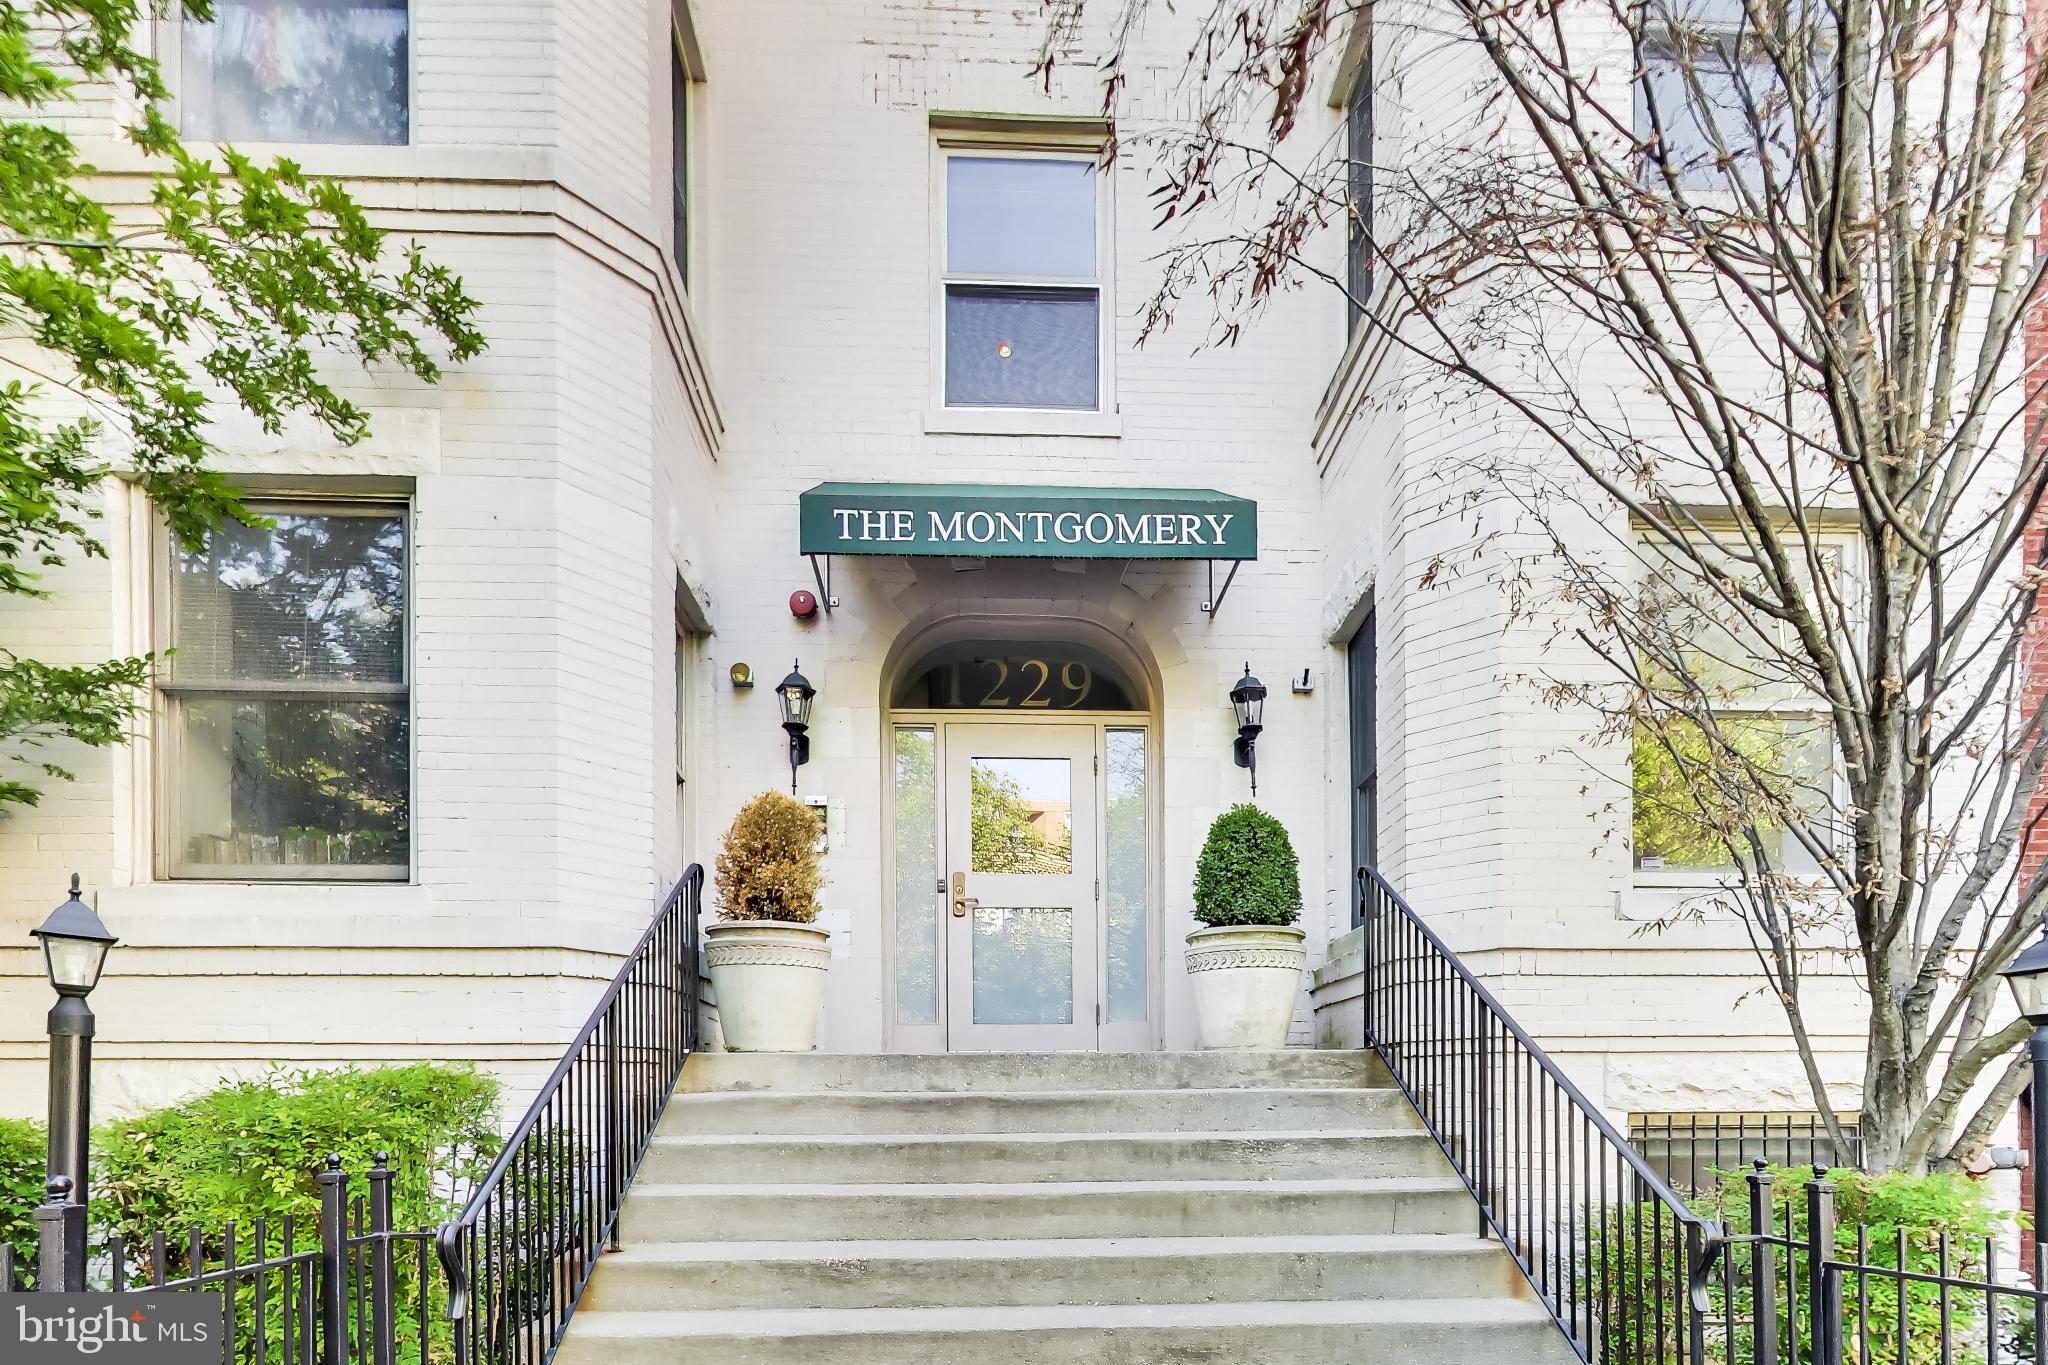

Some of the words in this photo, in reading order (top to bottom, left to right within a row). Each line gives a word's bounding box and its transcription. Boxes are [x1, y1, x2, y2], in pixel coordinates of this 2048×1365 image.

[833, 508, 916, 541] THE
[927, 511, 1234, 545] MONTGOMERY
[945, 659, 1092, 708] 1229
